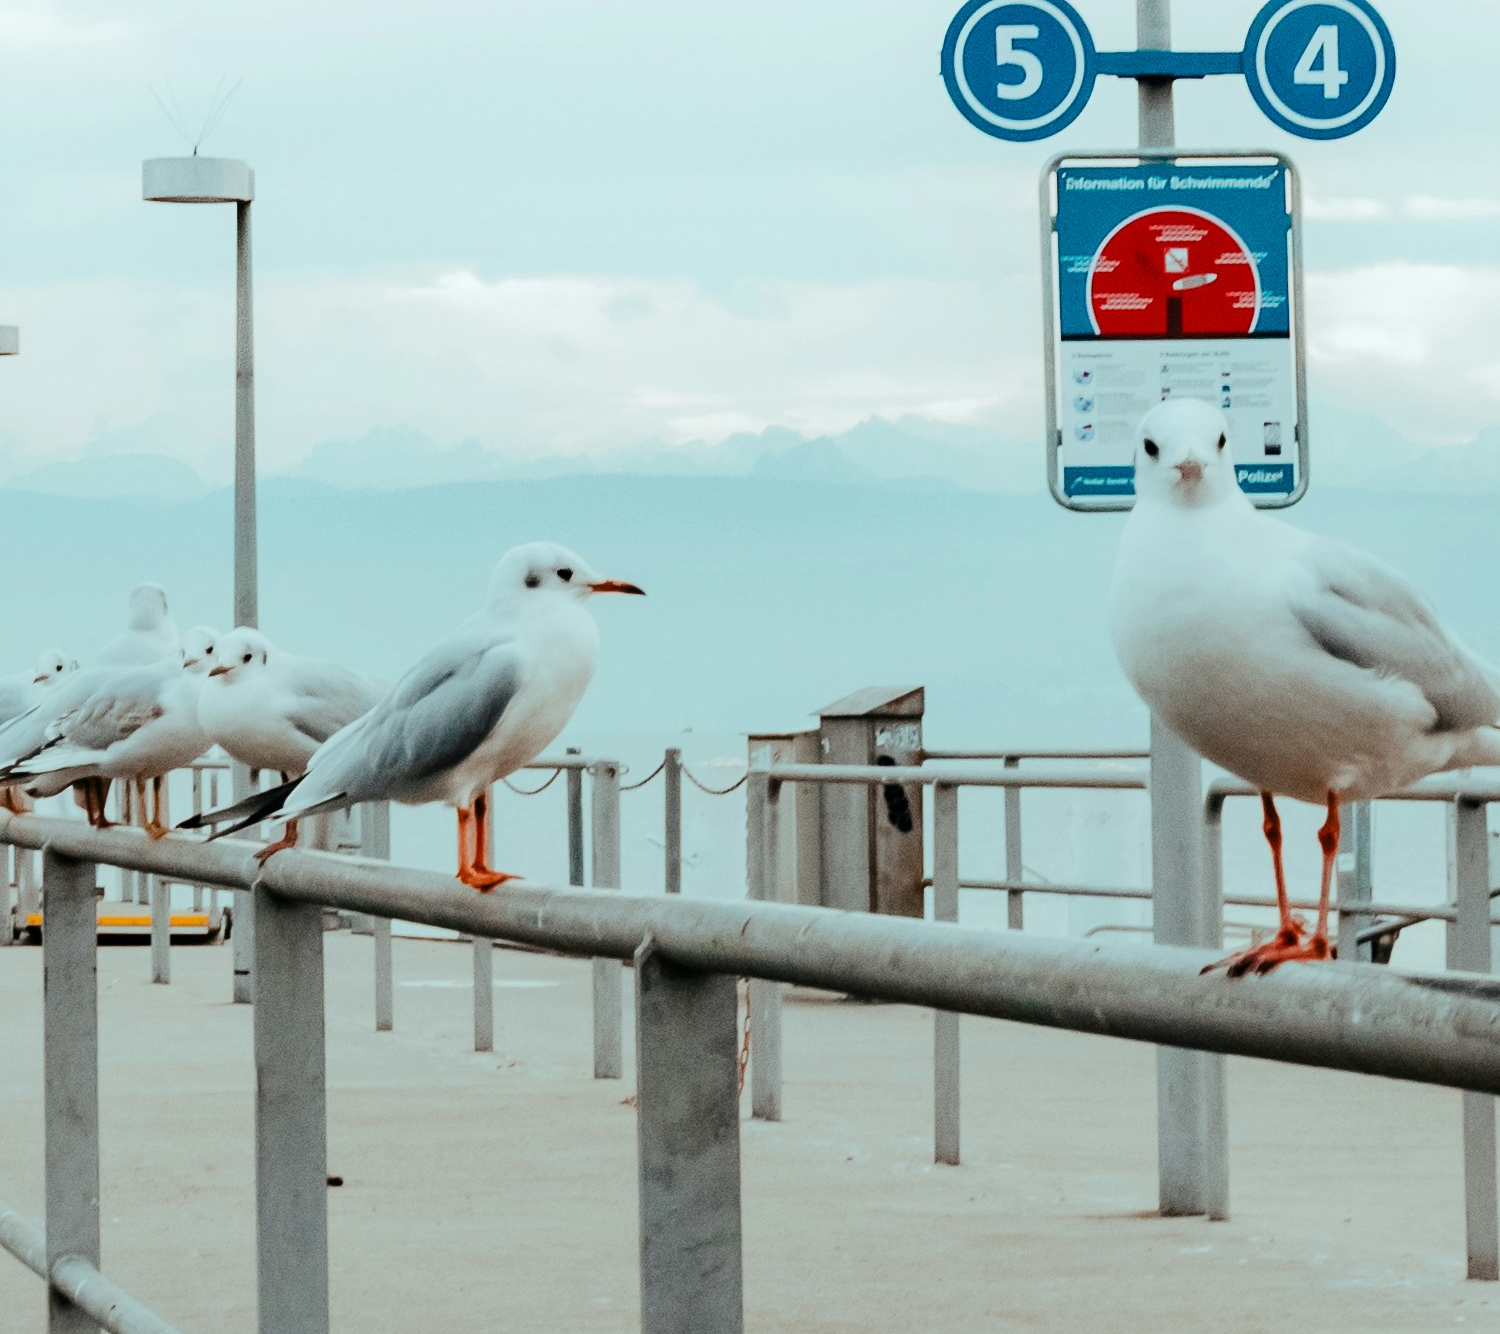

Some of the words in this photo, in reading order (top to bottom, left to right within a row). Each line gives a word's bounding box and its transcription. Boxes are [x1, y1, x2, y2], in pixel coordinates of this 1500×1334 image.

[994, 24, 1044, 100] 5
[1293, 24, 1349, 99] 4
[1066, 177, 1145, 190] Information
[1147, 176, 1167, 190] für
